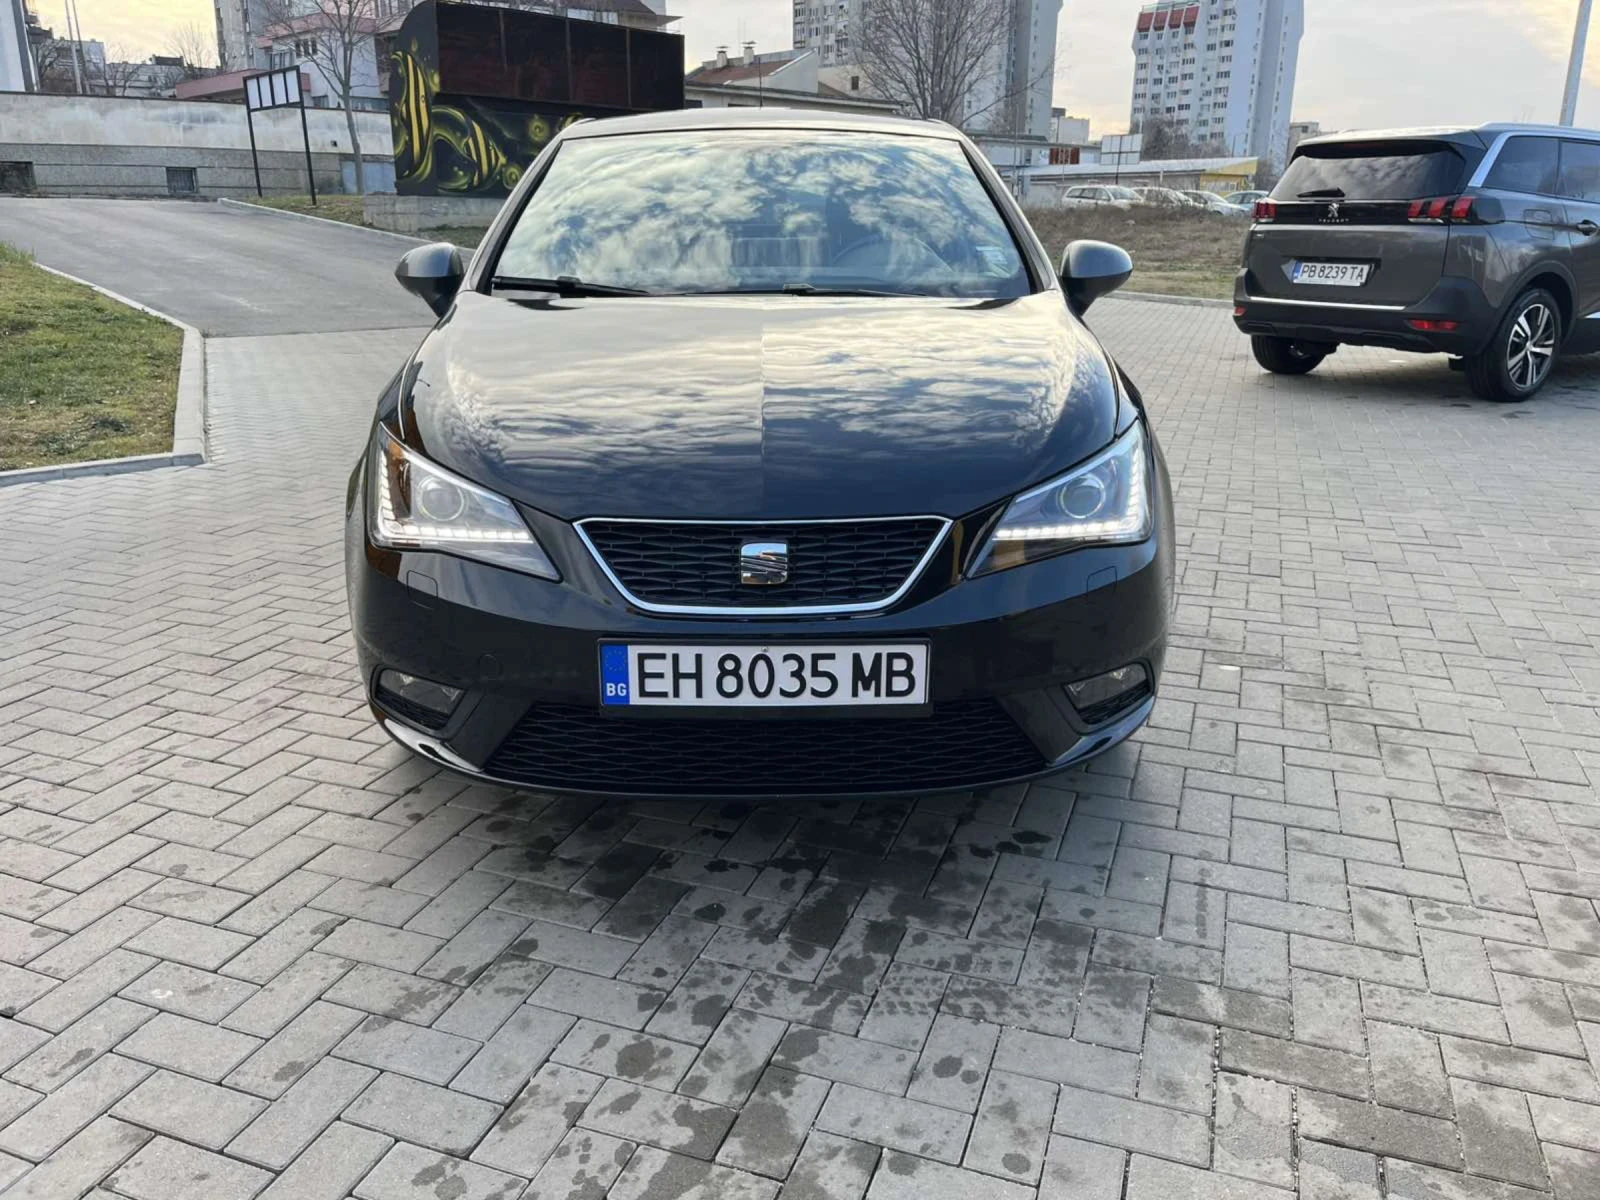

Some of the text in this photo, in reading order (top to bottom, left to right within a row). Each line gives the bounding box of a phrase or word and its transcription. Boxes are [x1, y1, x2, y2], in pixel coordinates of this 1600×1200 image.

[1301, 265, 1317, 278] PB
[1318, 266, 1347, 280] 8239
[1350, 267, 1364, 280] TA
[637, 652, 916, 698] EH 8035 MB
[606, 683, 627, 696] BG
